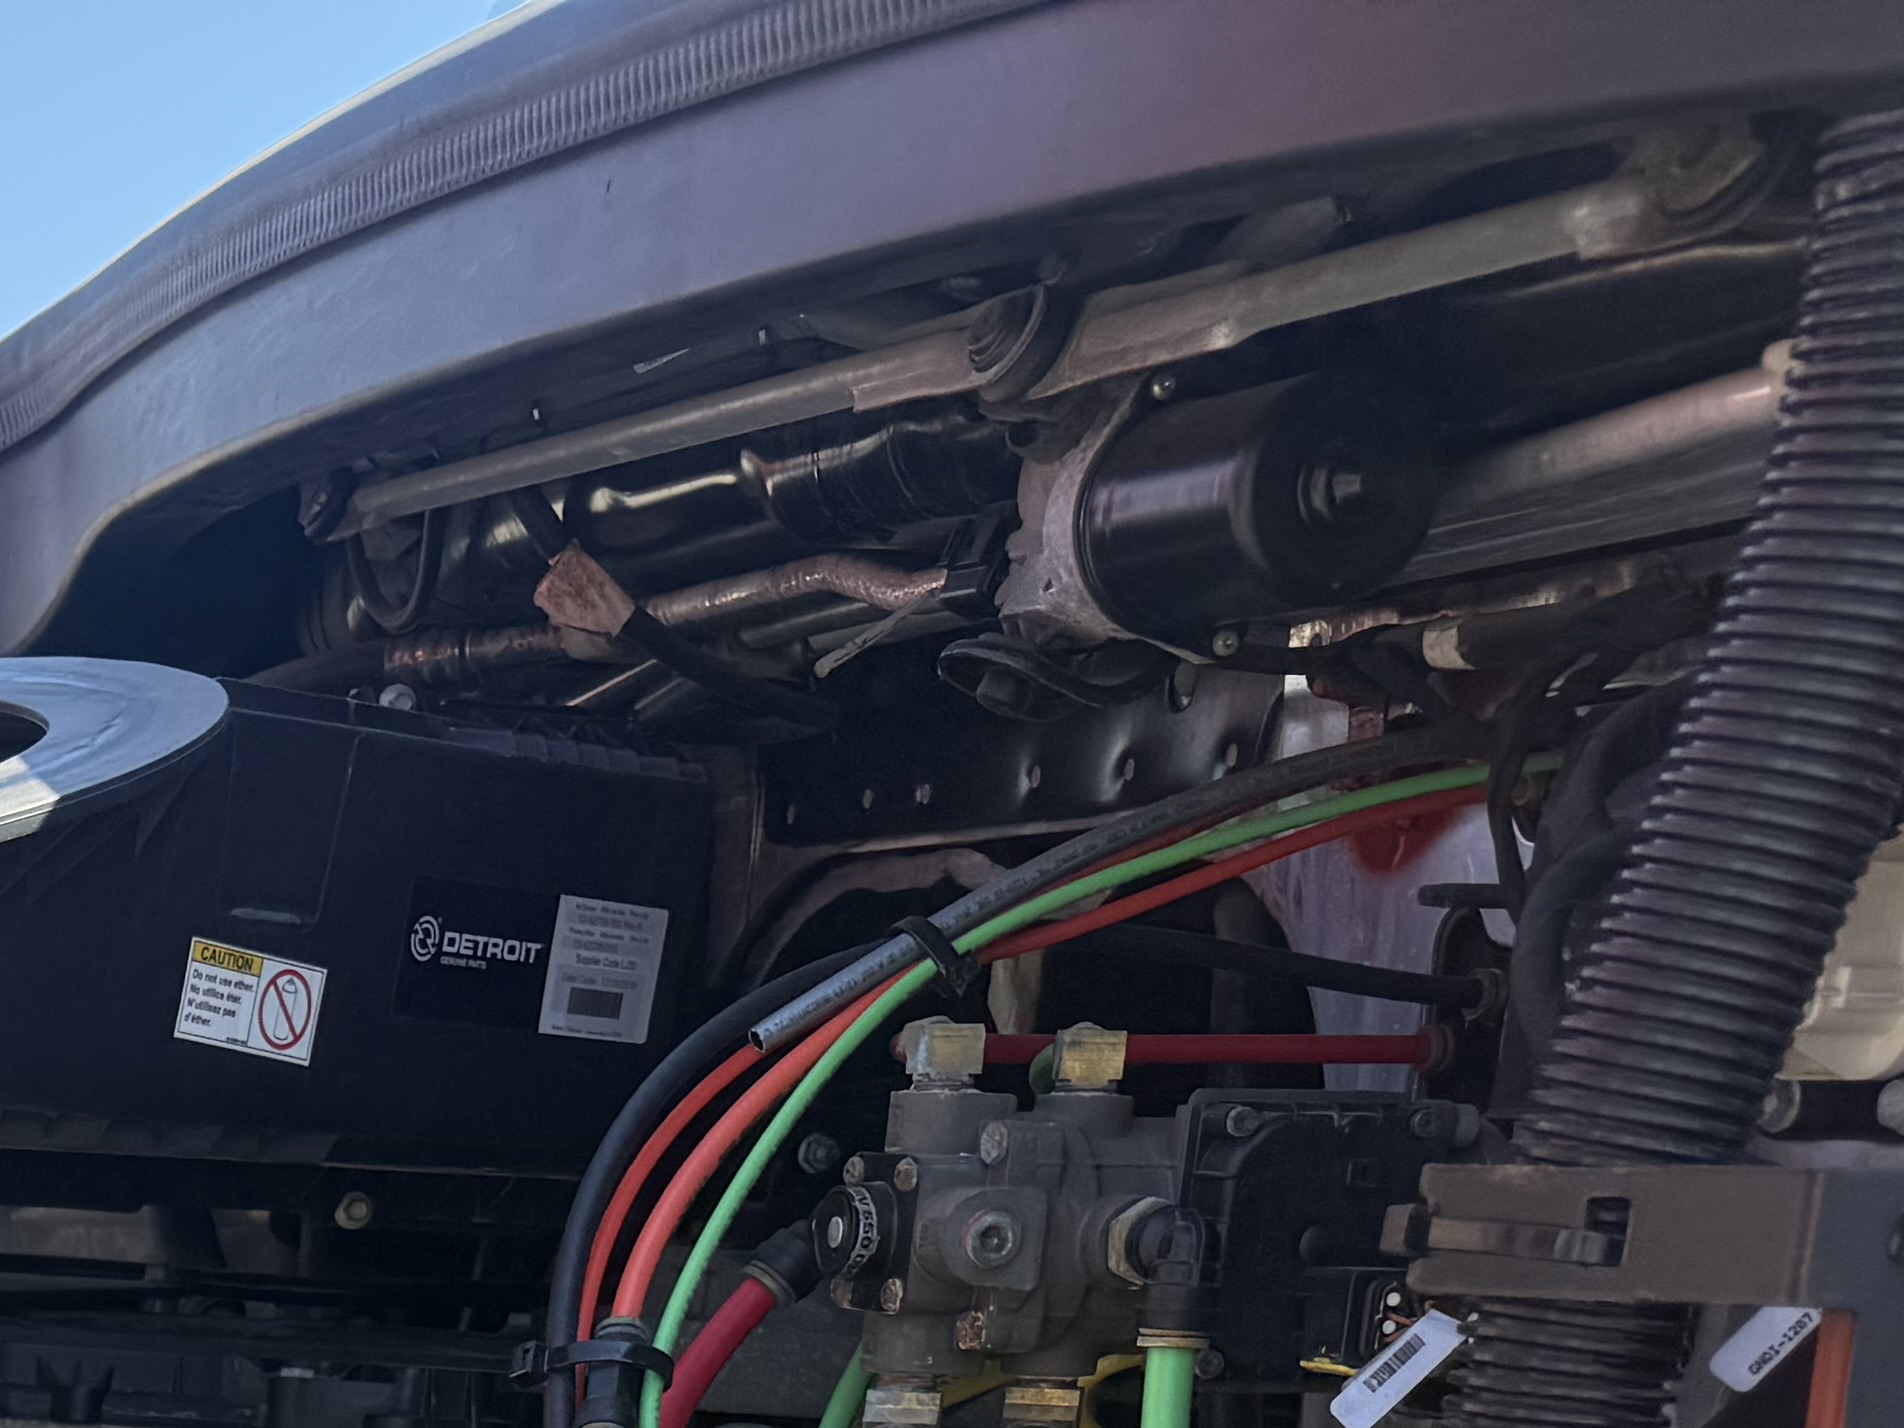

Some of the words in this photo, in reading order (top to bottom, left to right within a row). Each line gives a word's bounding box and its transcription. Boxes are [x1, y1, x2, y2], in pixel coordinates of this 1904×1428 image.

[442, 932, 542, 963] DETROIT
[201, 947, 254, 971] CAUTION
[193, 970, 203, 979] Do
[205, 974, 217, 983] not
[219, 978, 233, 986] use
[190, 985, 200, 993] No
